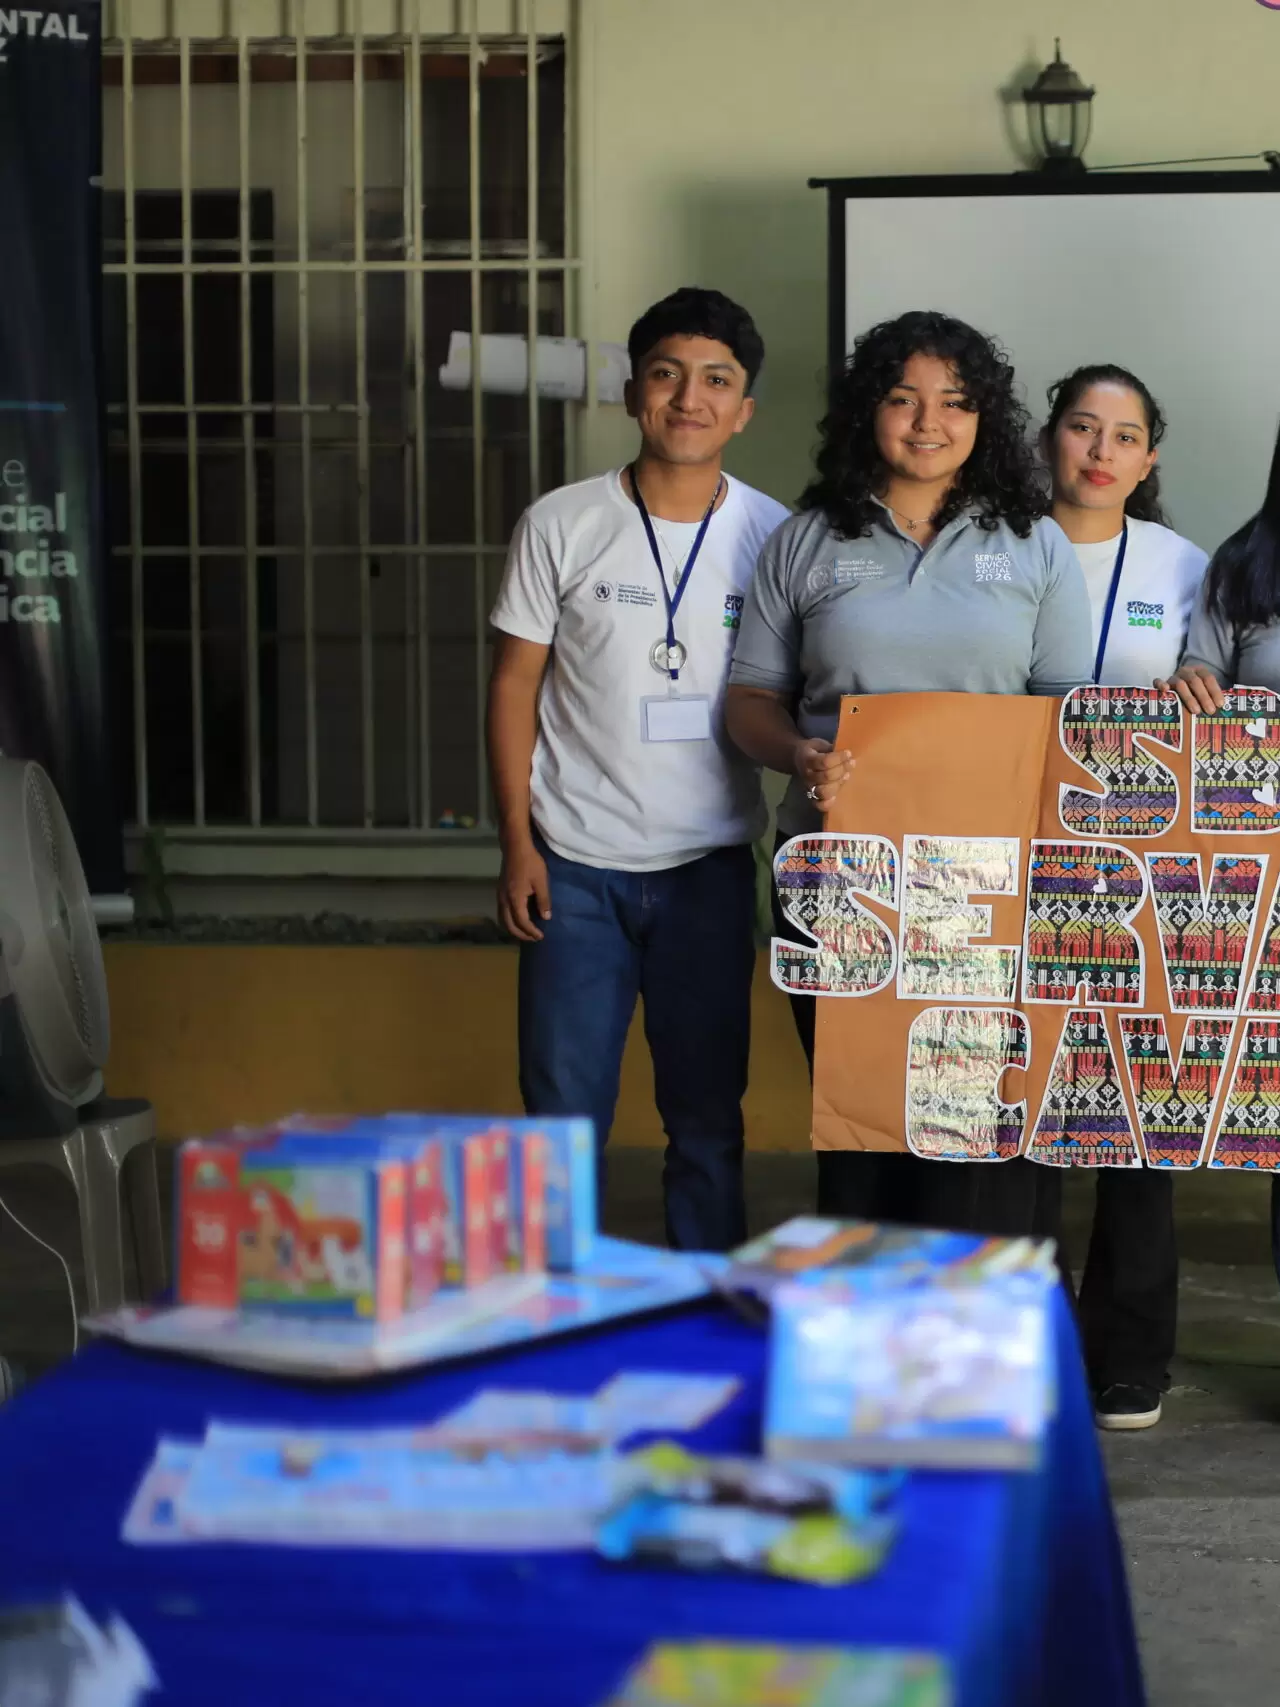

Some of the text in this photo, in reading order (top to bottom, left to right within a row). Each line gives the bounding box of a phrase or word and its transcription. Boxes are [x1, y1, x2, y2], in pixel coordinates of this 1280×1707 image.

[0, 491, 67, 532] cial
[975, 552, 1010, 561] SERVICIO
[975, 560, 1011, 569] CIVICO
[976, 573, 1012, 582] 2026
[1127, 606, 1164, 615] CIVICO
[1127, 617, 1162, 630] 2026
